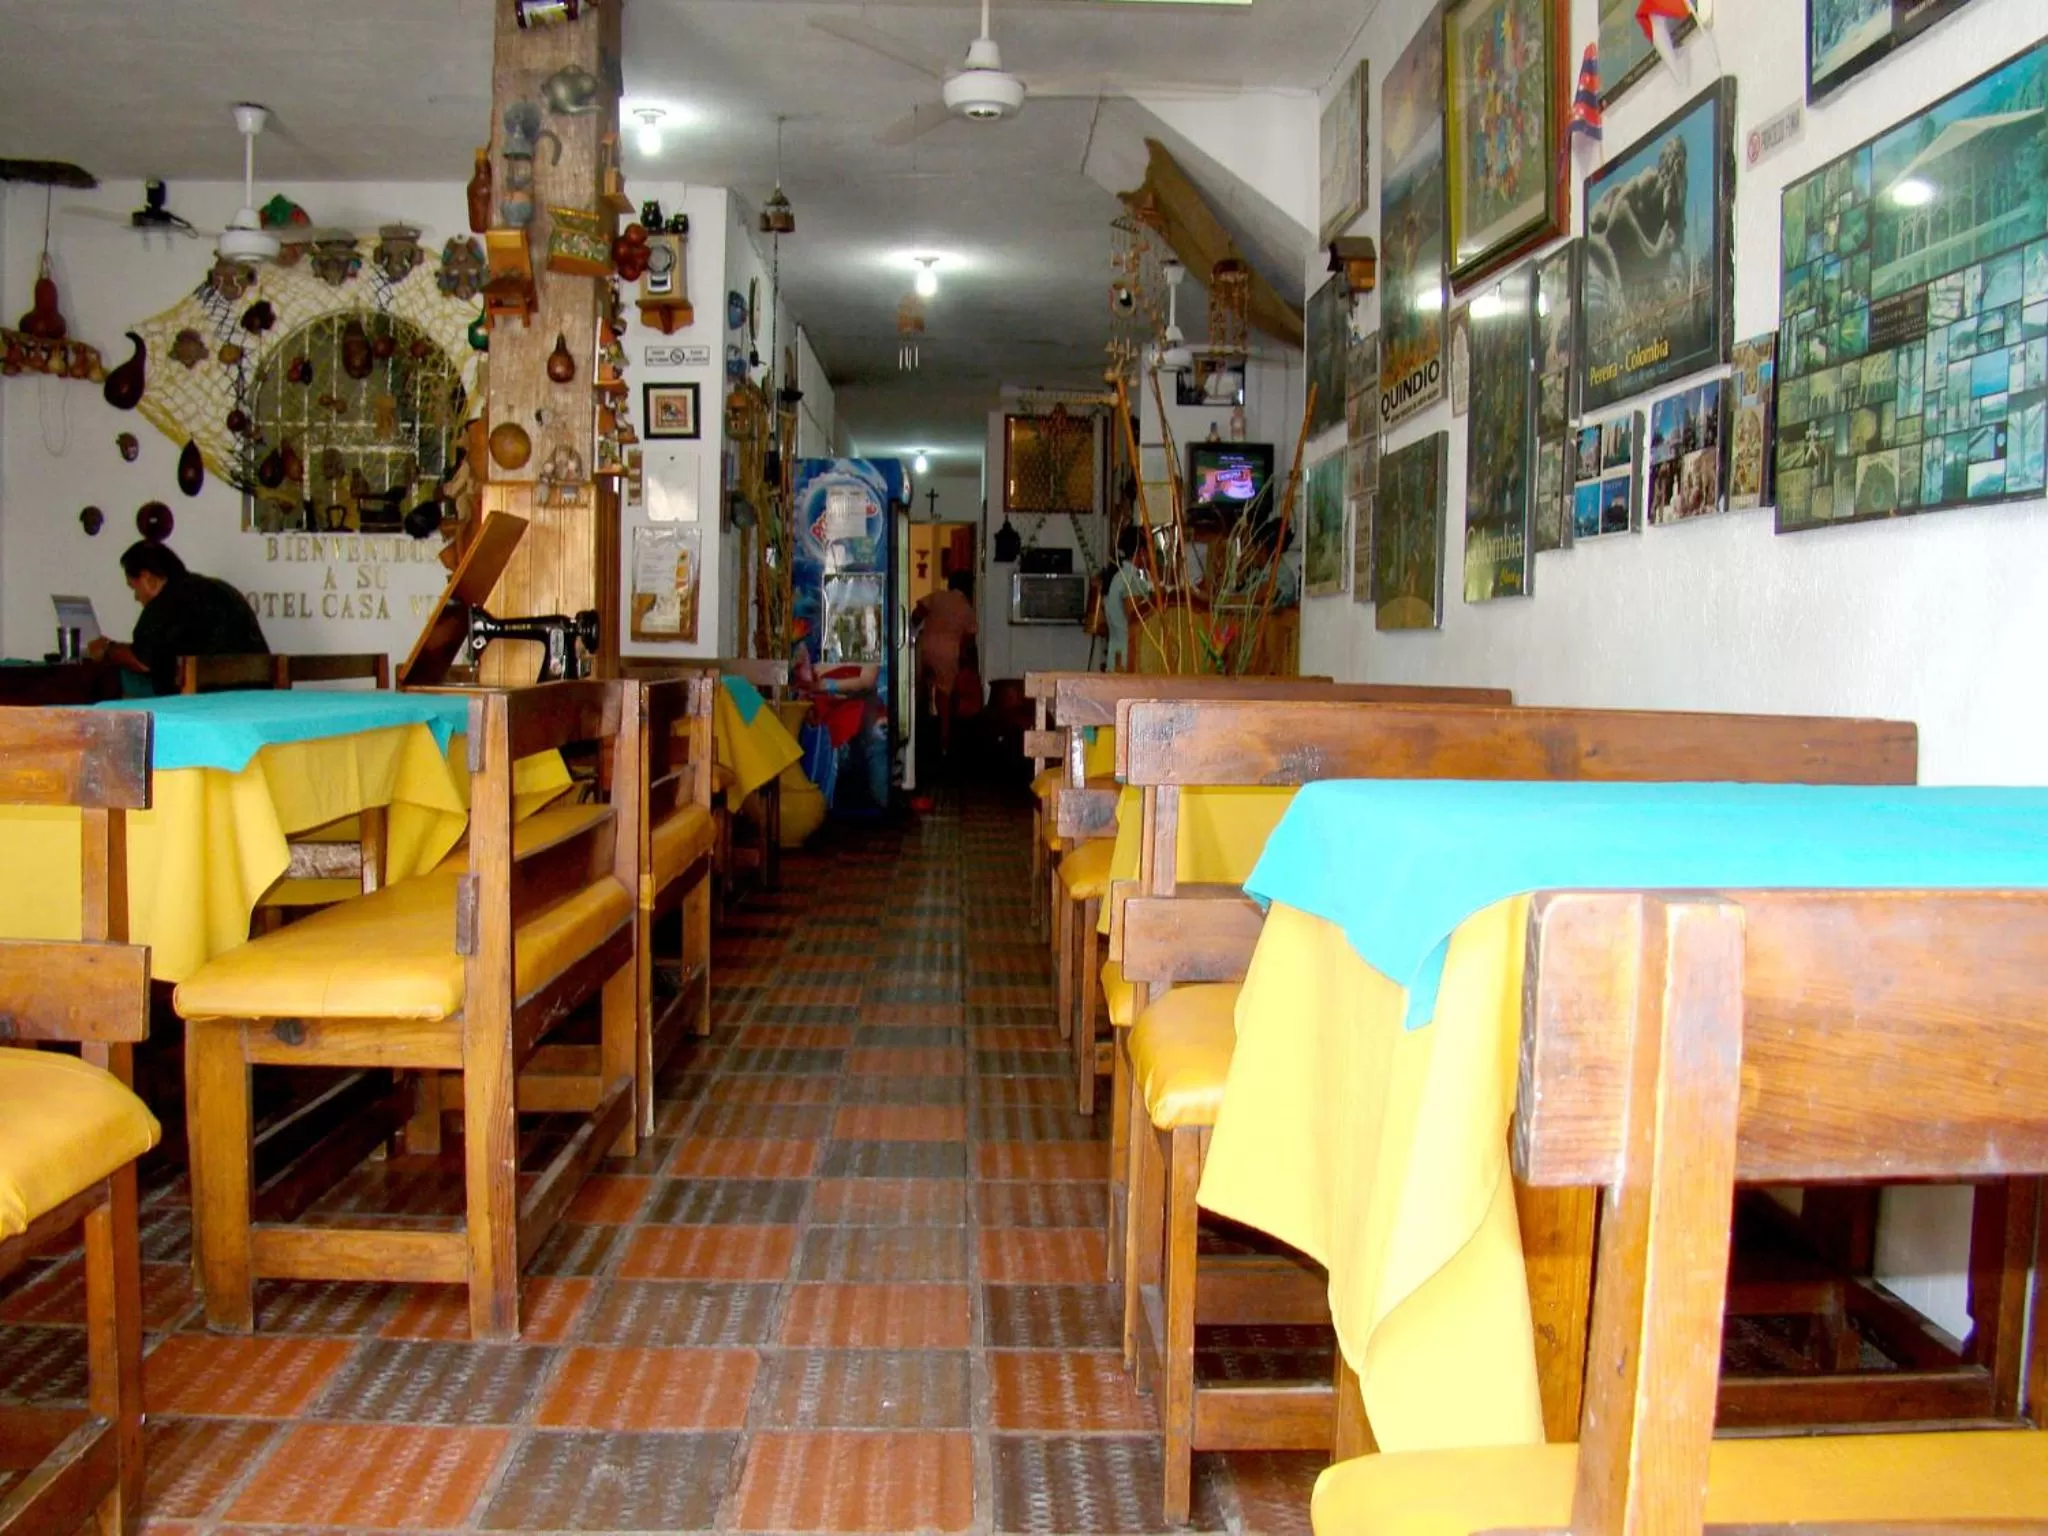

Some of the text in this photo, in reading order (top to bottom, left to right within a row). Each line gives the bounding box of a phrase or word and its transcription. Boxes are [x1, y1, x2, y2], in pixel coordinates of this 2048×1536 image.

[1590, 361, 1617, 388] Pereira
[1625, 336, 1669, 372] Colombia
[1381, 358, 1440, 422] QUINDIO
[323, 565, 389, 590] A SU
[247, 592, 313, 618] OTEL
[322, 593, 391, 620] CASA
